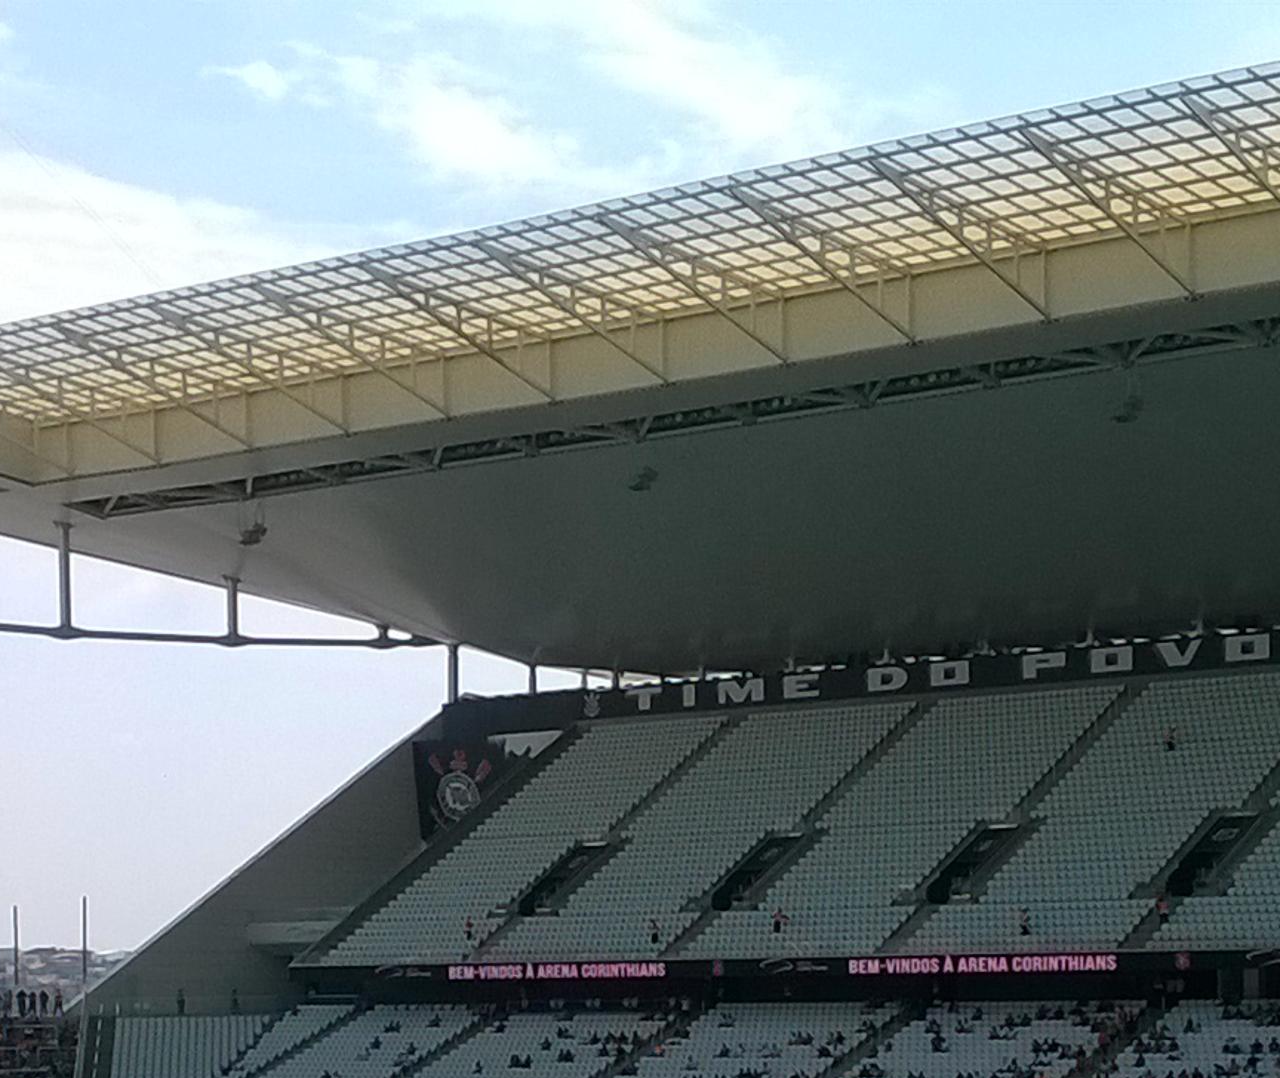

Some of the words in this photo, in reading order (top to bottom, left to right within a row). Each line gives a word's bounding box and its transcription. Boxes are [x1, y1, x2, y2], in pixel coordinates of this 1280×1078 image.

[625, 673, 820, 711] TIME
[867, 660, 970, 692] DO
[1022, 632, 1270, 680] POVO
[448, 964, 524, 980] BEM-VINDOS
[525, 961, 534, 979] À
[537, 964, 579, 979] ARENA
[581, 963, 666, 979] CORINTHIANS
[848, 957, 940, 974] BEM-VINDOS
[943, 953, 954, 973] À
[957, 956, 1009, 973] ARENA
[1012, 954, 1117, 972] CORINTHIANS
